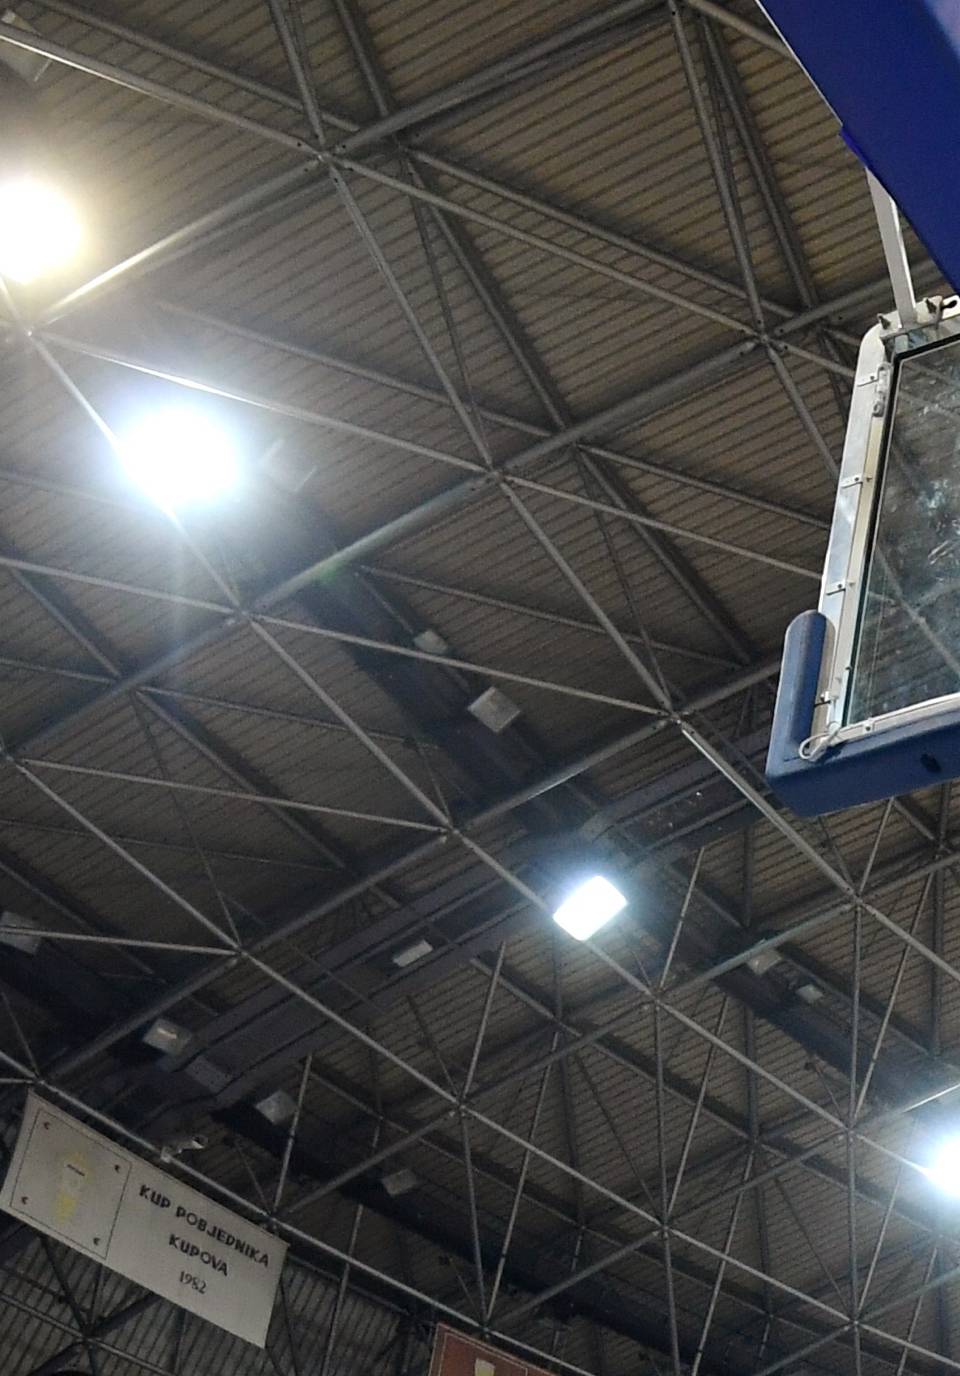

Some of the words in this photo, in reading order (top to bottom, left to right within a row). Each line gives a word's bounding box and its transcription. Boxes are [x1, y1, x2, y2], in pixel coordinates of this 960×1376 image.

[139, 1184, 171, 1208] KUP
[176, 1206, 269, 1268] POBJEDNIKA
[169, 1234, 228, 1277] KUPOVA
[180, 1271, 207, 1294] 1982
